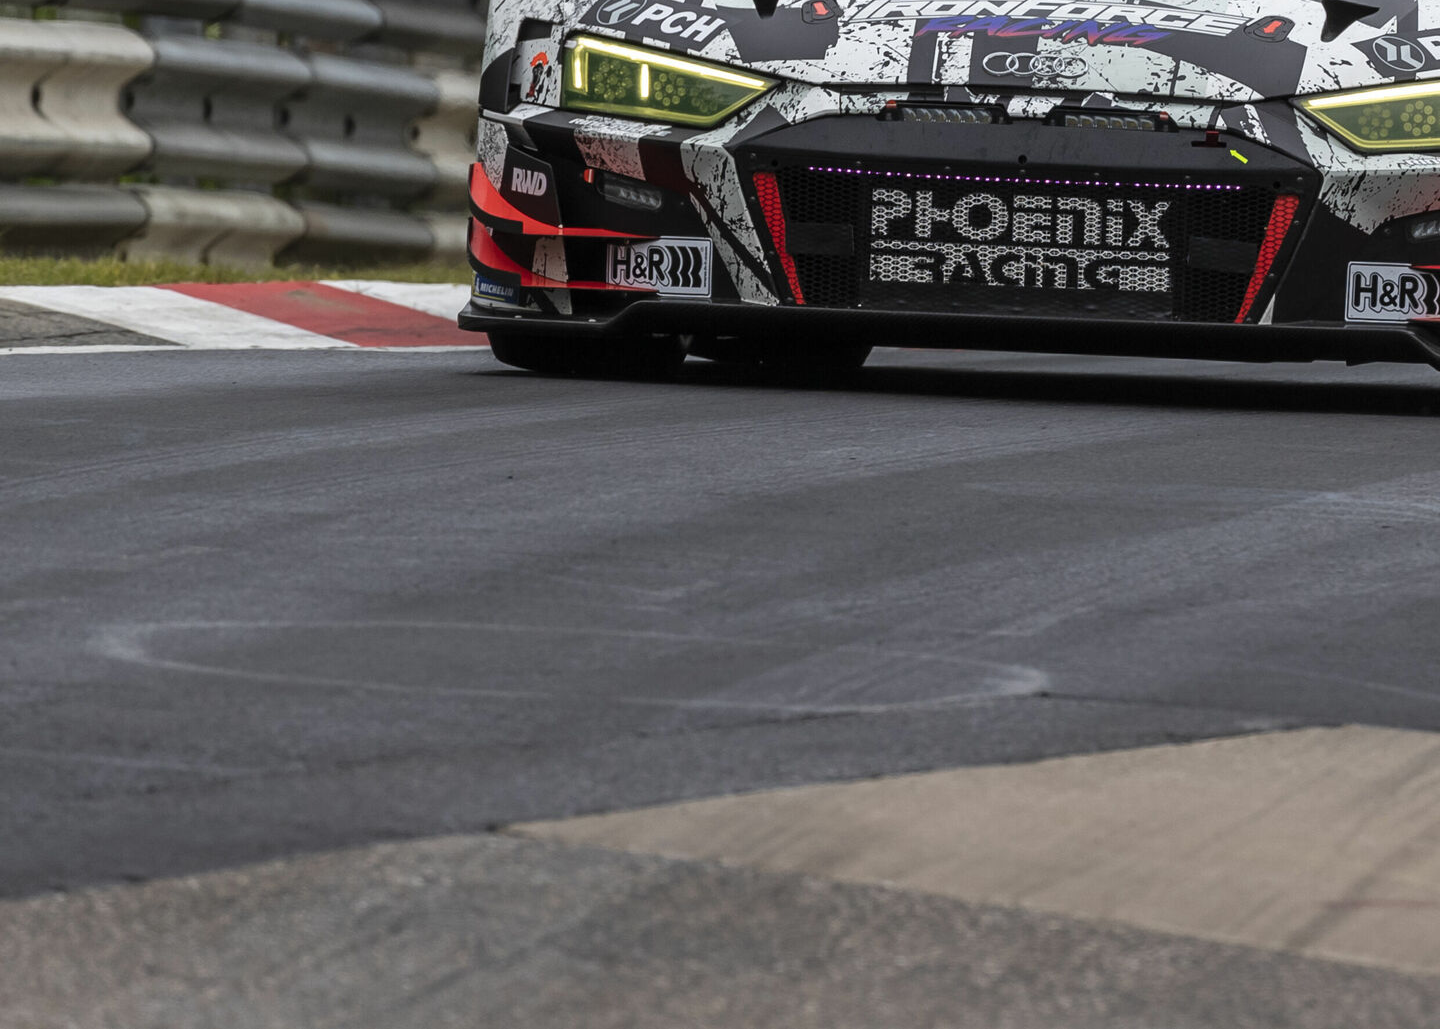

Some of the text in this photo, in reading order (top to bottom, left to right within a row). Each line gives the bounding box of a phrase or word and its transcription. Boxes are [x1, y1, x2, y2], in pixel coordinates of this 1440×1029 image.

[631, 3, 727, 42] PCH
[914, 16, 1173, 45] RACING
[511, 167, 548, 197] RWD
[612, 244, 669, 286] H&R
[479, 282, 514, 297] MICHELIN
[1352, 271, 1425, 314] H&R
